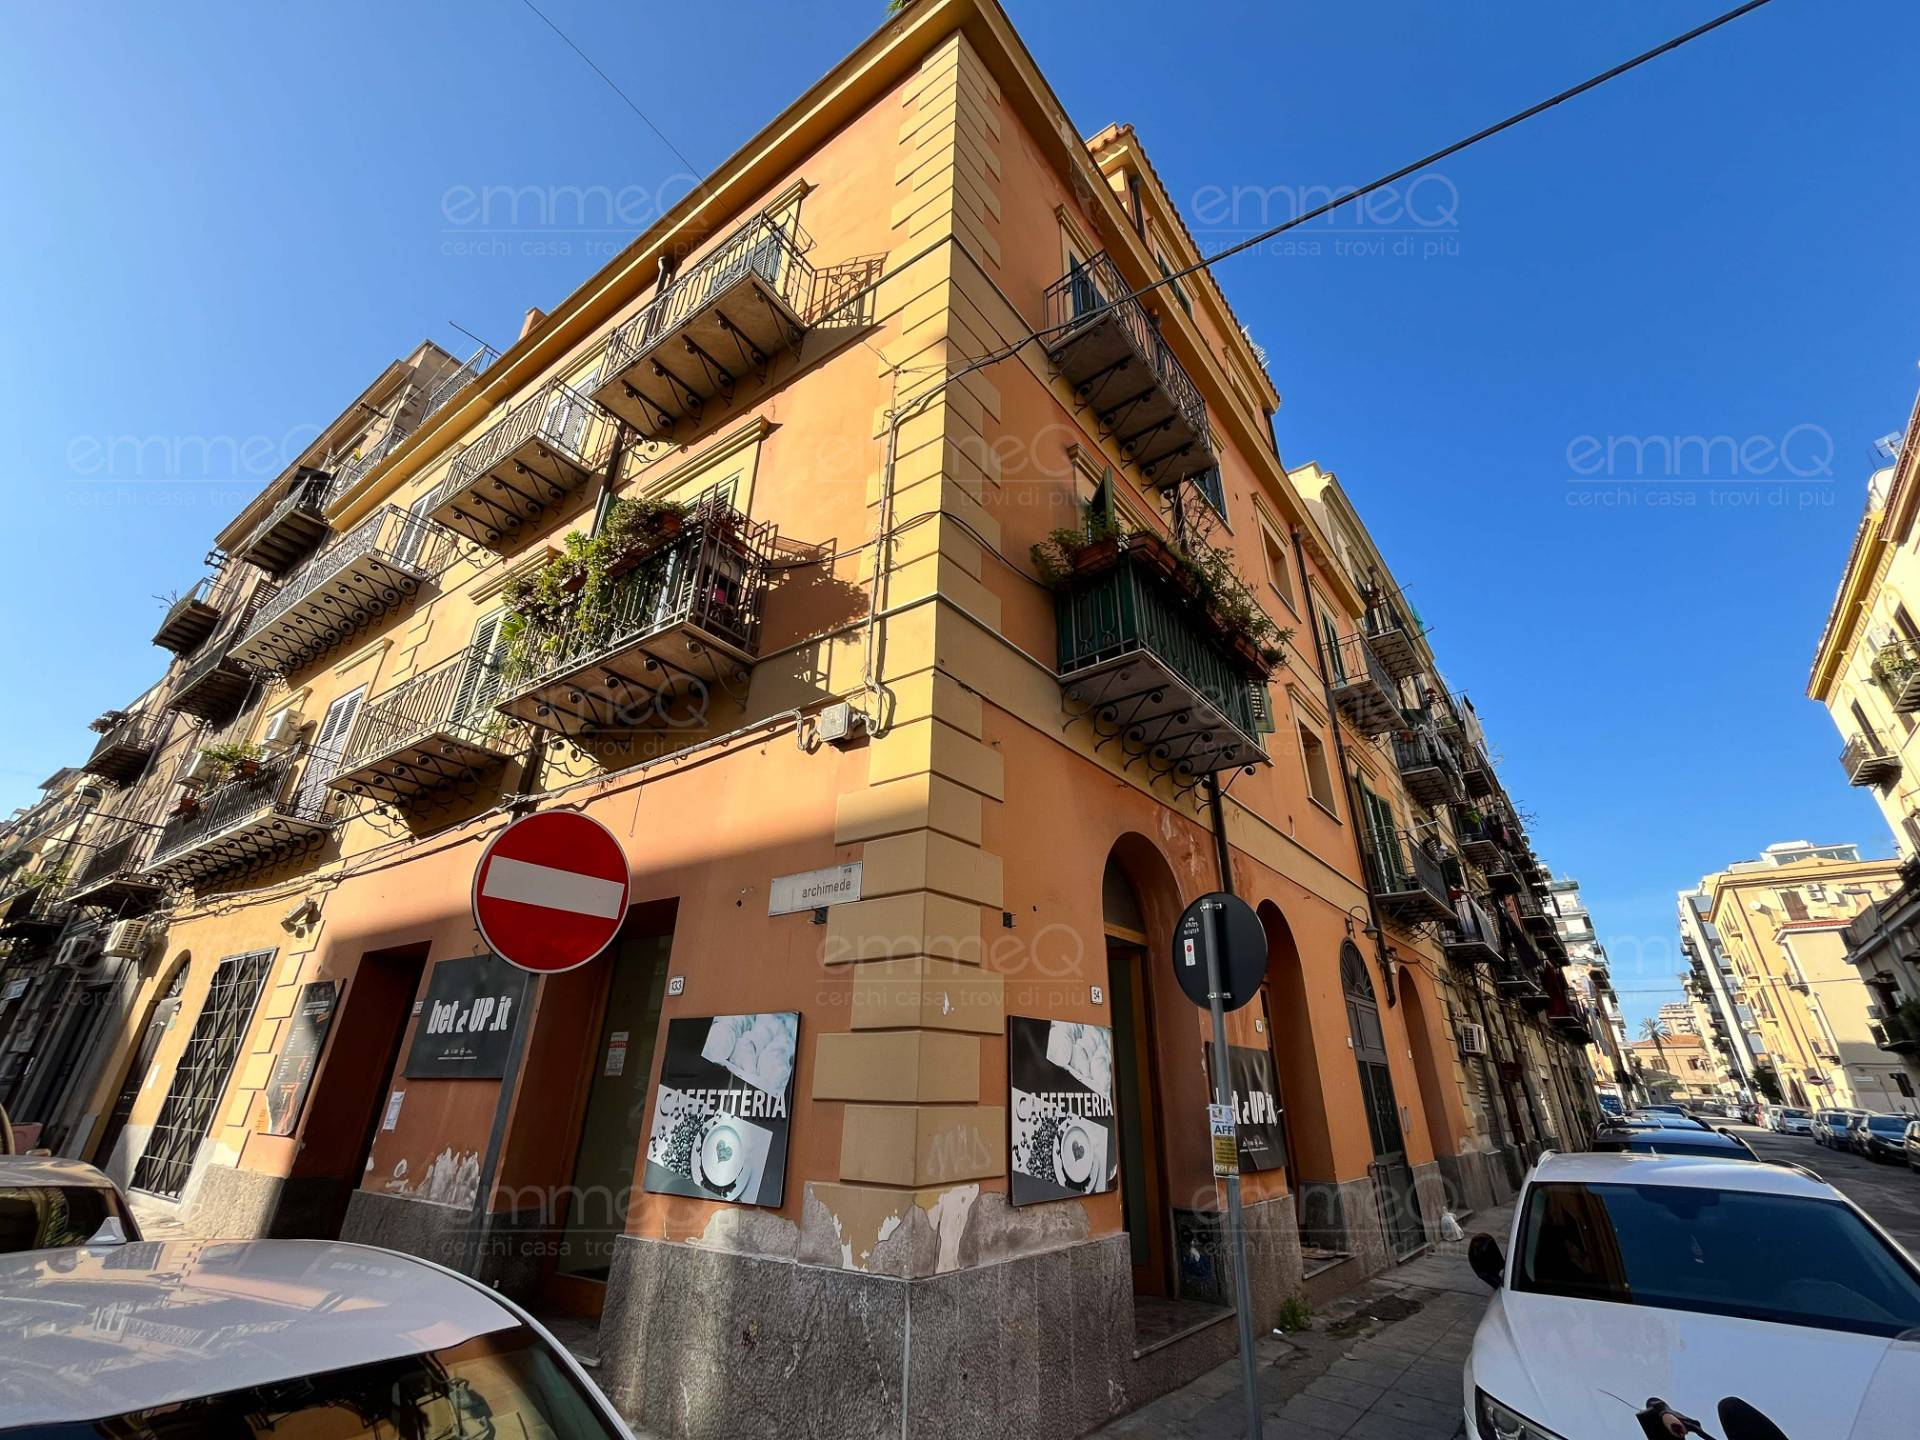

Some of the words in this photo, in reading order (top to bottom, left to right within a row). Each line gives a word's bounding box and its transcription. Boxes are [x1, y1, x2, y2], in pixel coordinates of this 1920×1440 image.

[802, 879, 852, 898] archimede
[659, 1089, 786, 1118] CAFFETTERIA
[1016, 1092, 1114, 1122] CAFFETTERIA
